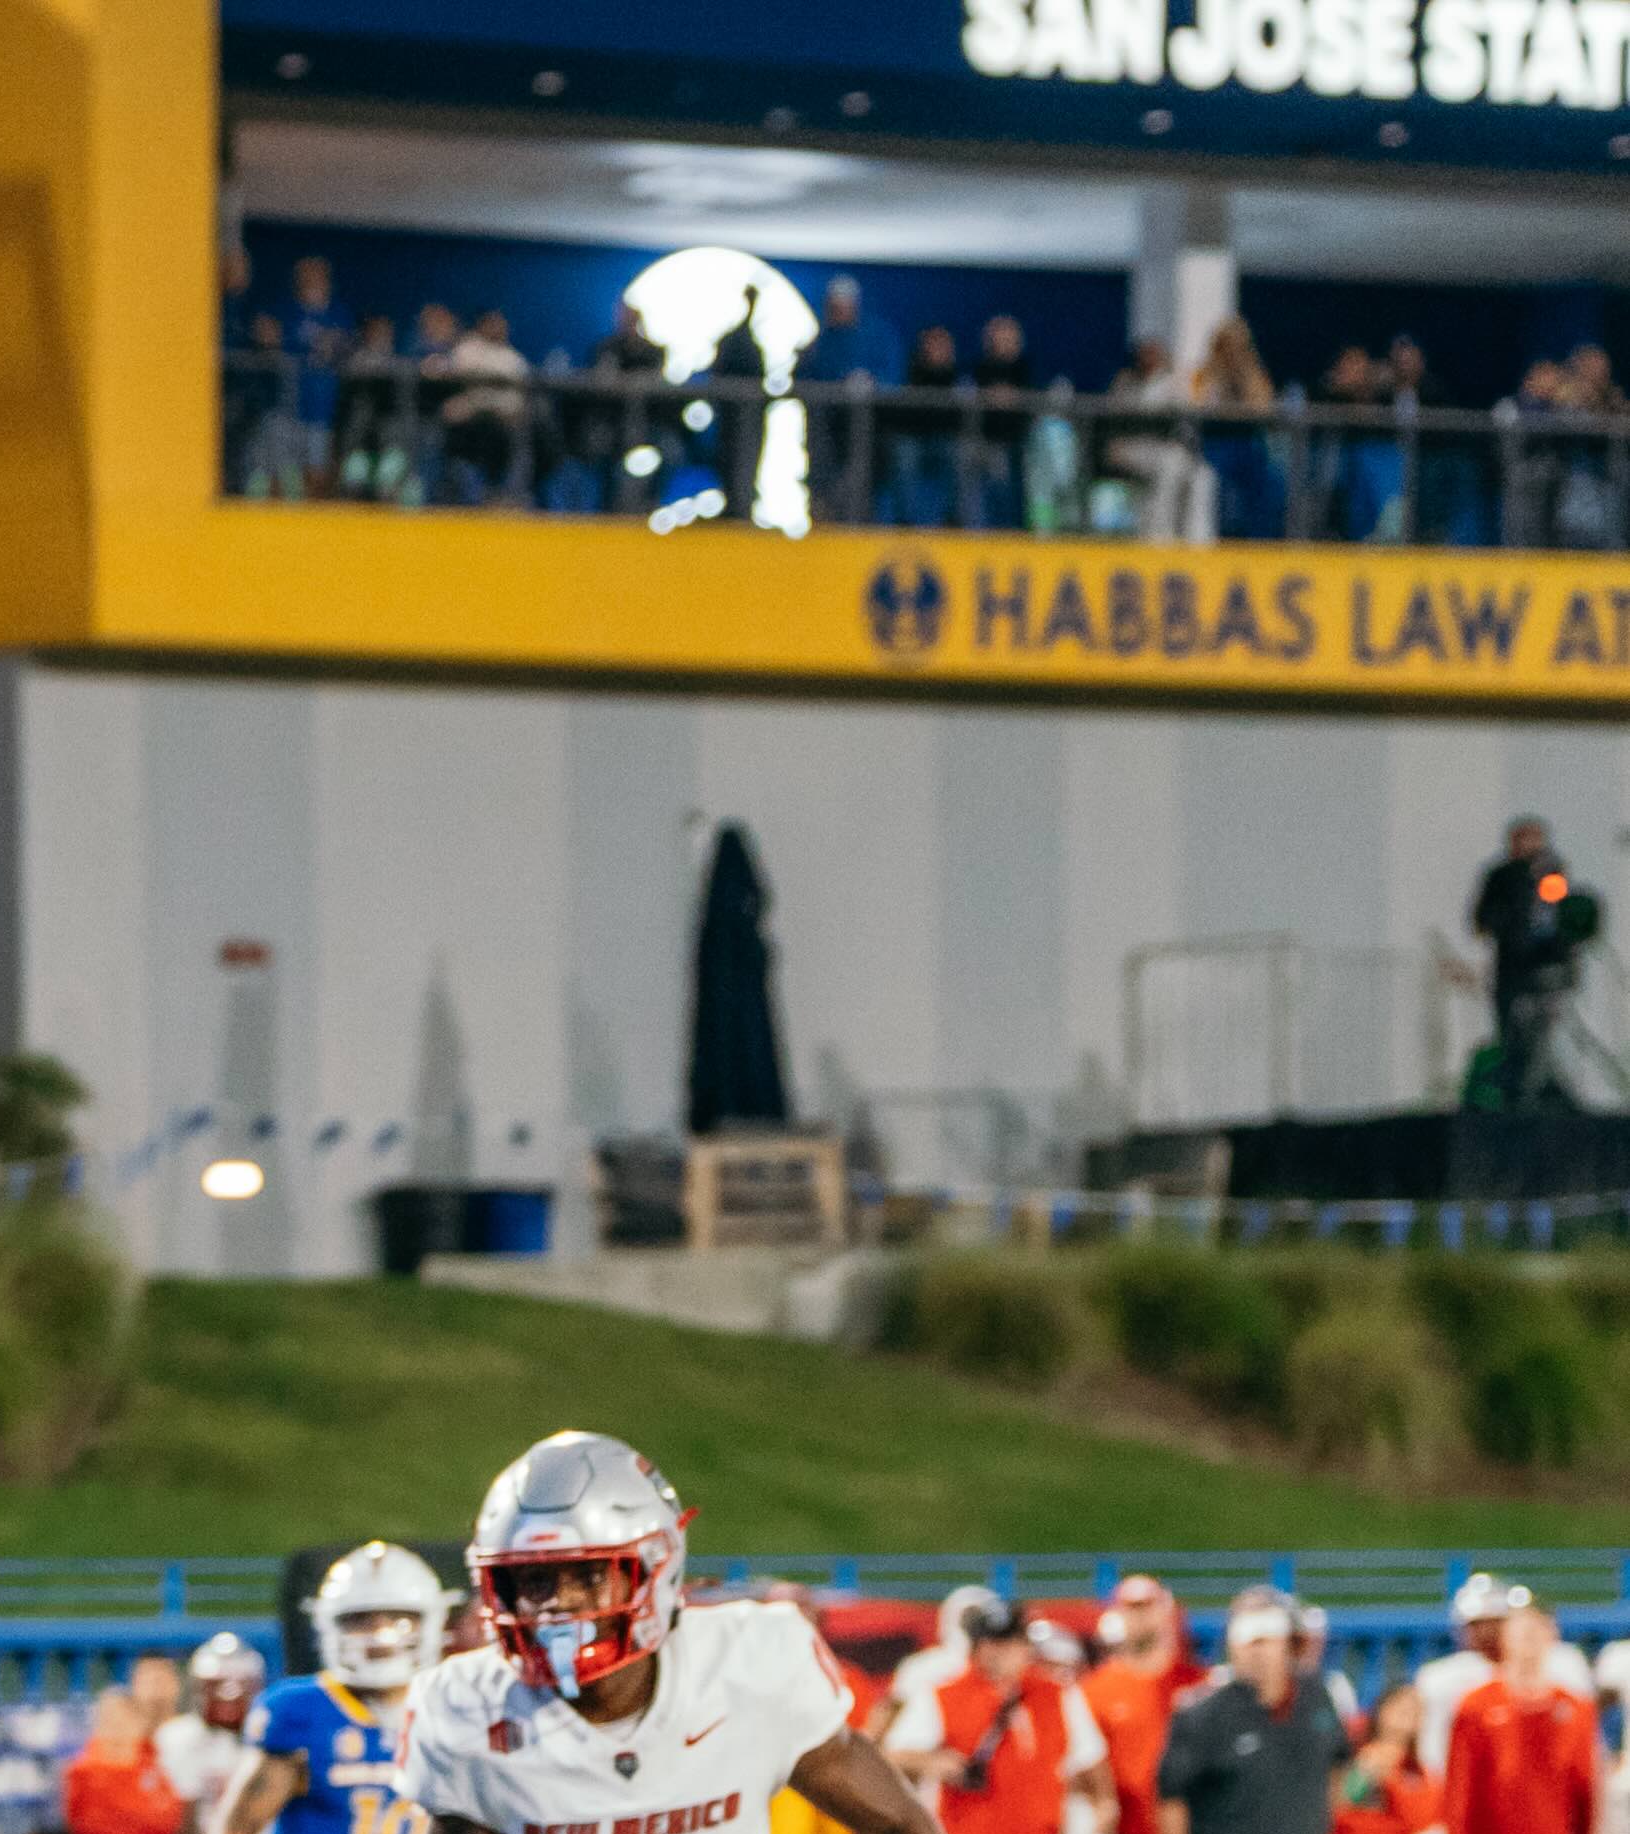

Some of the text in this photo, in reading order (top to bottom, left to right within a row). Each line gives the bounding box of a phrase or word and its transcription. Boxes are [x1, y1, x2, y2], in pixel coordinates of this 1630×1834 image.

[961, 0, 1168, 85] SAN
[1421, 0, 1630, 111] STAT
[973, 564, 1316, 663] HABBAS
[1348, 575, 1532, 667] LAW
